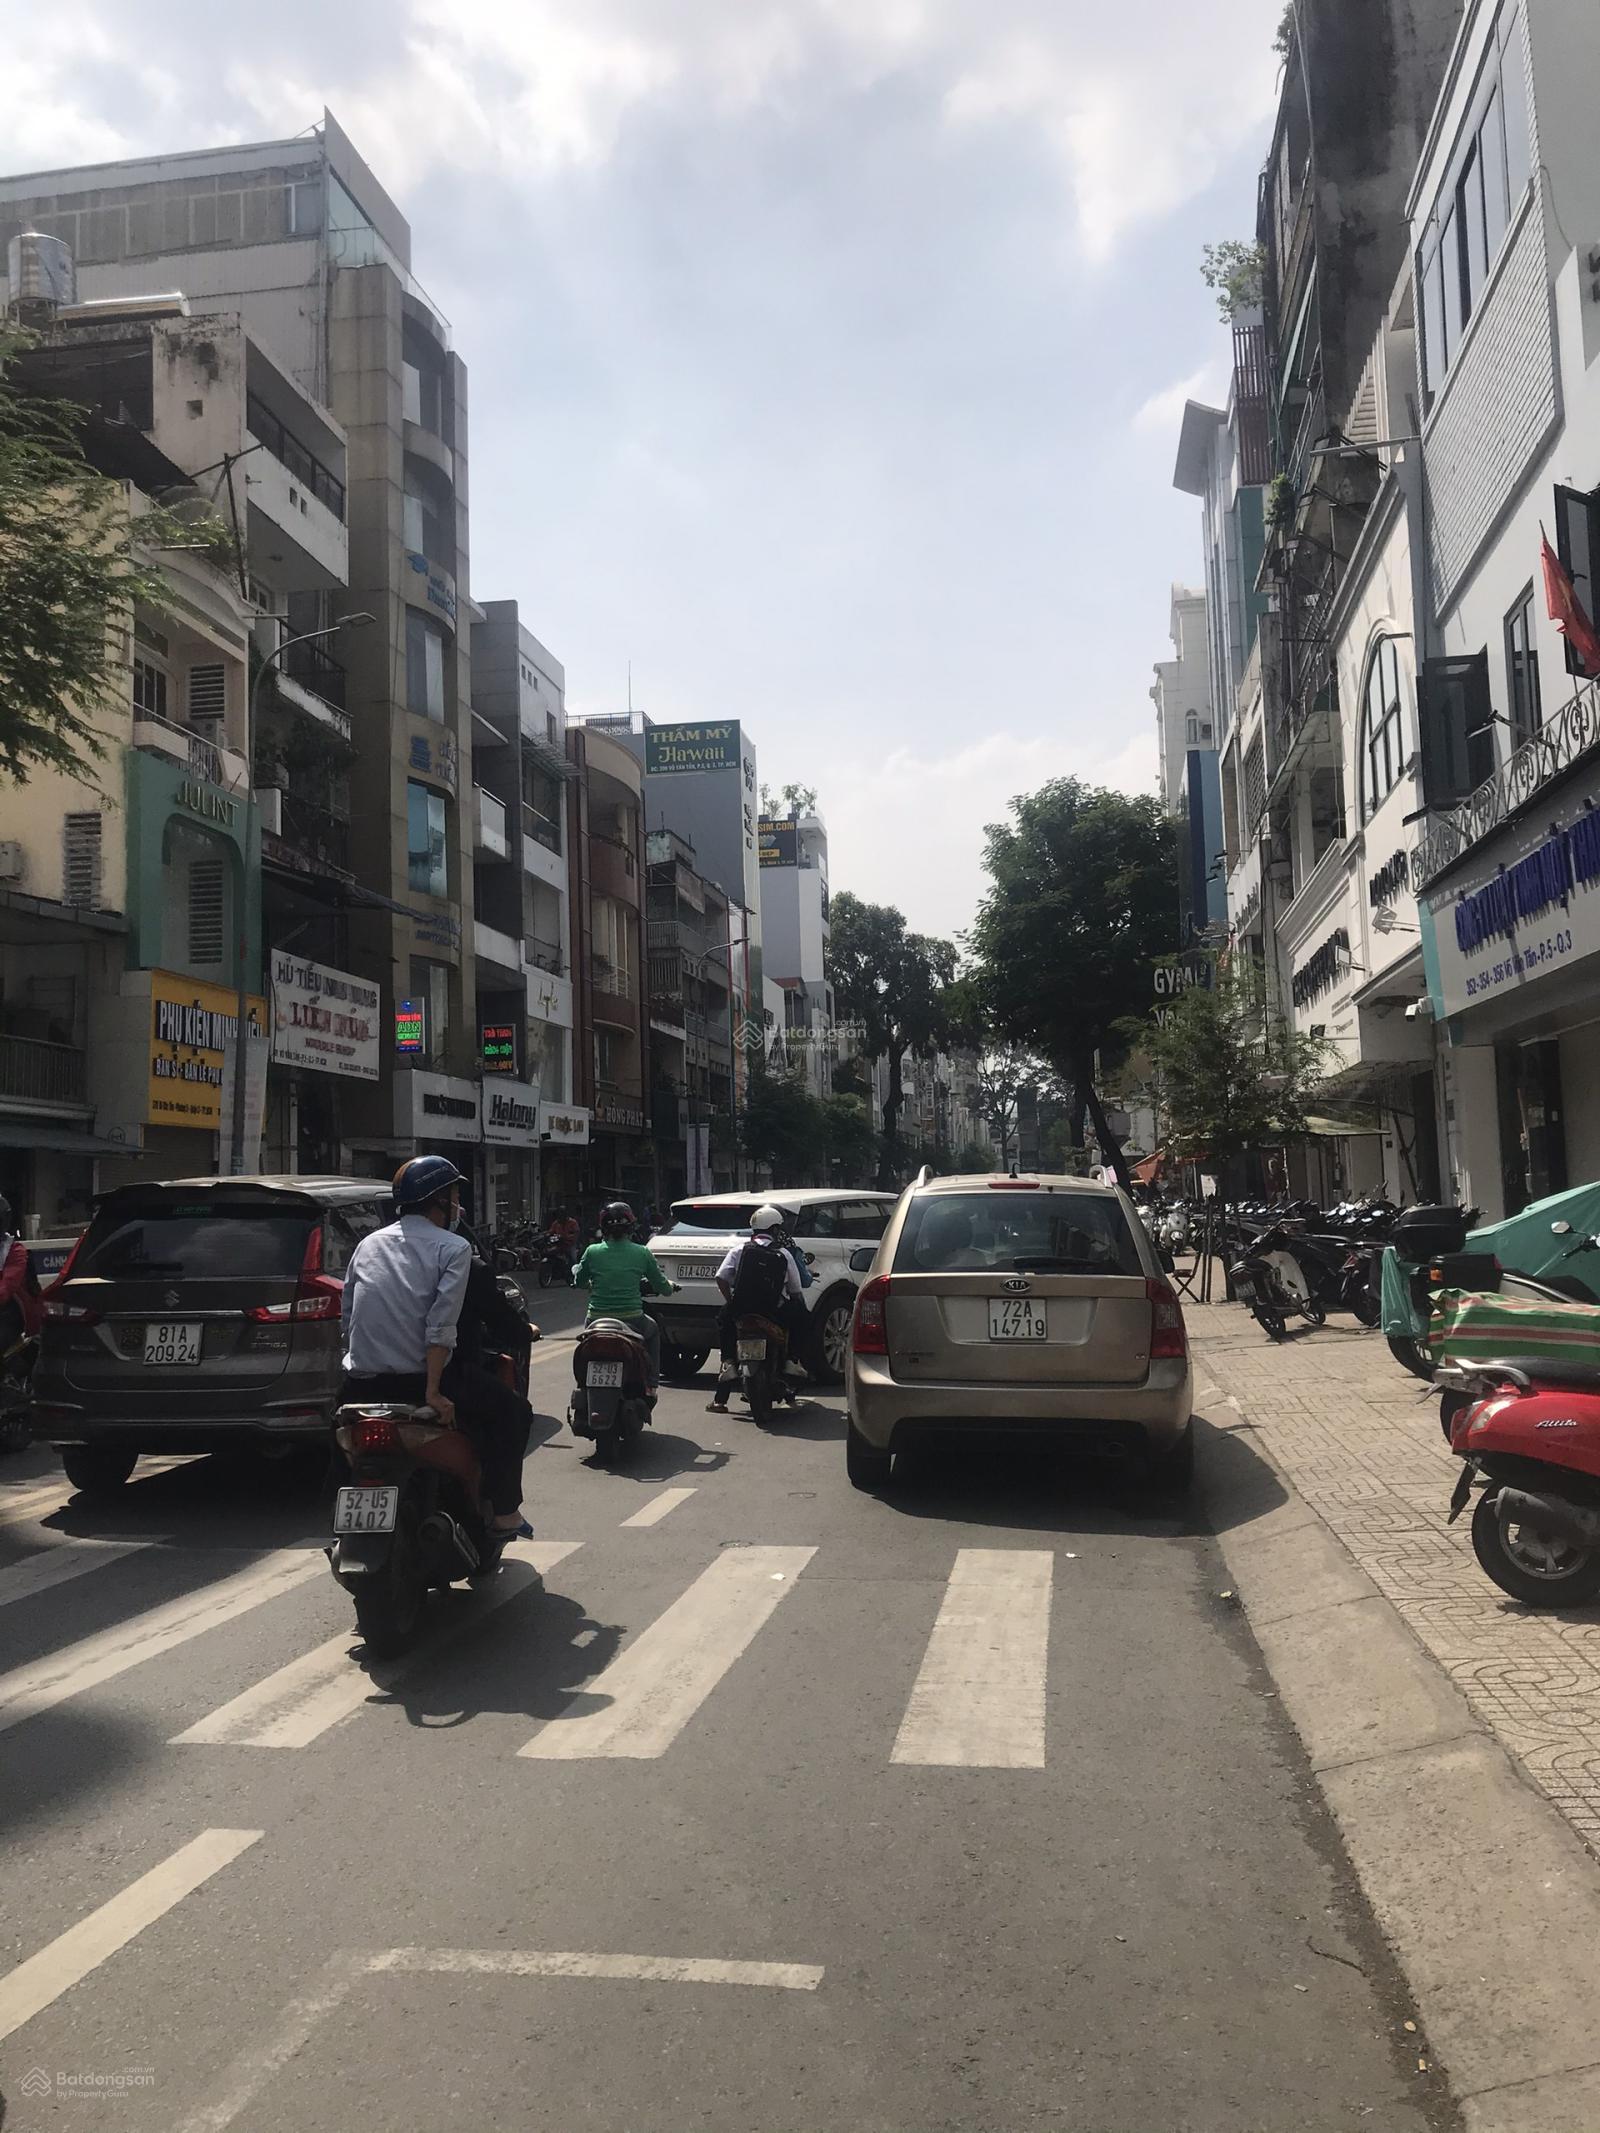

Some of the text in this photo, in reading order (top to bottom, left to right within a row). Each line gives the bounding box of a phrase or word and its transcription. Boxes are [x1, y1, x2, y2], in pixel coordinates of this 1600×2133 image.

[650, 726, 700, 743] THẨM
[705, 724, 733, 740] MỸ
[159, 1000, 183, 1052] PHỤ
[185, 999, 211, 1056] KIỆN
[1008, 1281, 1025, 1289] KIA
[1003, 1300, 1032, 1319] 72A
[159, 1325, 188, 1343] 81A
[992, 1319, 1045, 1337] 147.19
[145, 1344, 197, 1363] 209.24
[591, 1375, 617, 1386] 6622
[345, 1490, 389, 1510] 52-U5
[343, 1511, 387, 1529] 3402
